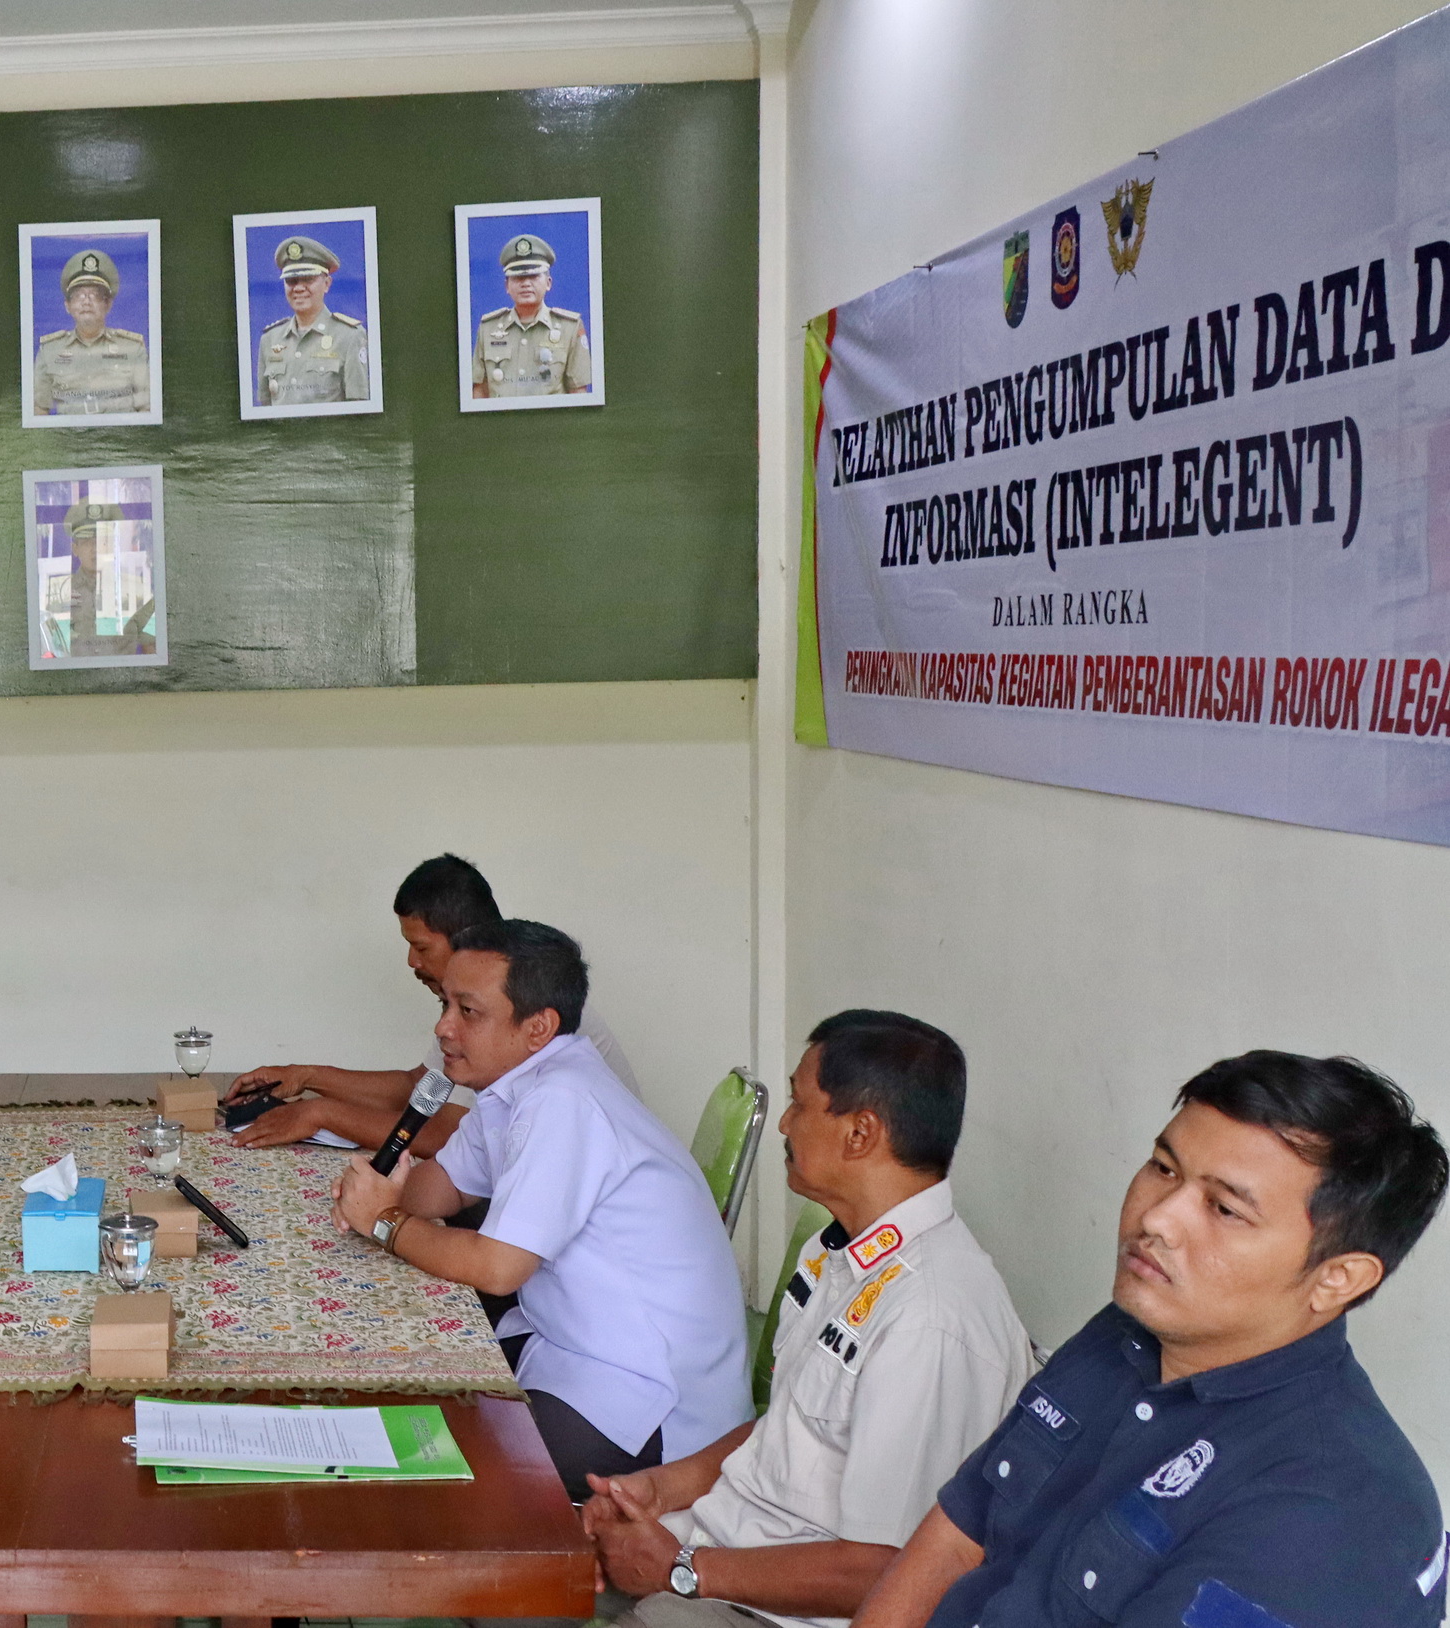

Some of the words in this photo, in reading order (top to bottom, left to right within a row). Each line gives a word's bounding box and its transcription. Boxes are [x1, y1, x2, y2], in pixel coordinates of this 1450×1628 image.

[831, 393, 957, 487] PELATIHAN
[964, 305, 1241, 458] PENGUMPULAN
[1252, 258, 1396, 392] DATA
[880, 479, 1037, 568] INFORMASI
[1045, 416, 1363, 572] (INTELEGENT)
[992, 594, 1053, 626] DALAM
[1063, 589, 1148, 625] RANGKA
[845, 651, 917, 699] PENINGKATAN
[920, 652, 996, 705] KAPASITAS
[997, 654, 1078, 710] KEGIATAN
[1081, 655, 1266, 724] PEMBERANTASAN
[1269, 657, 1368, 731] ROKOK
[818, 1322, 844, 1354] POL
